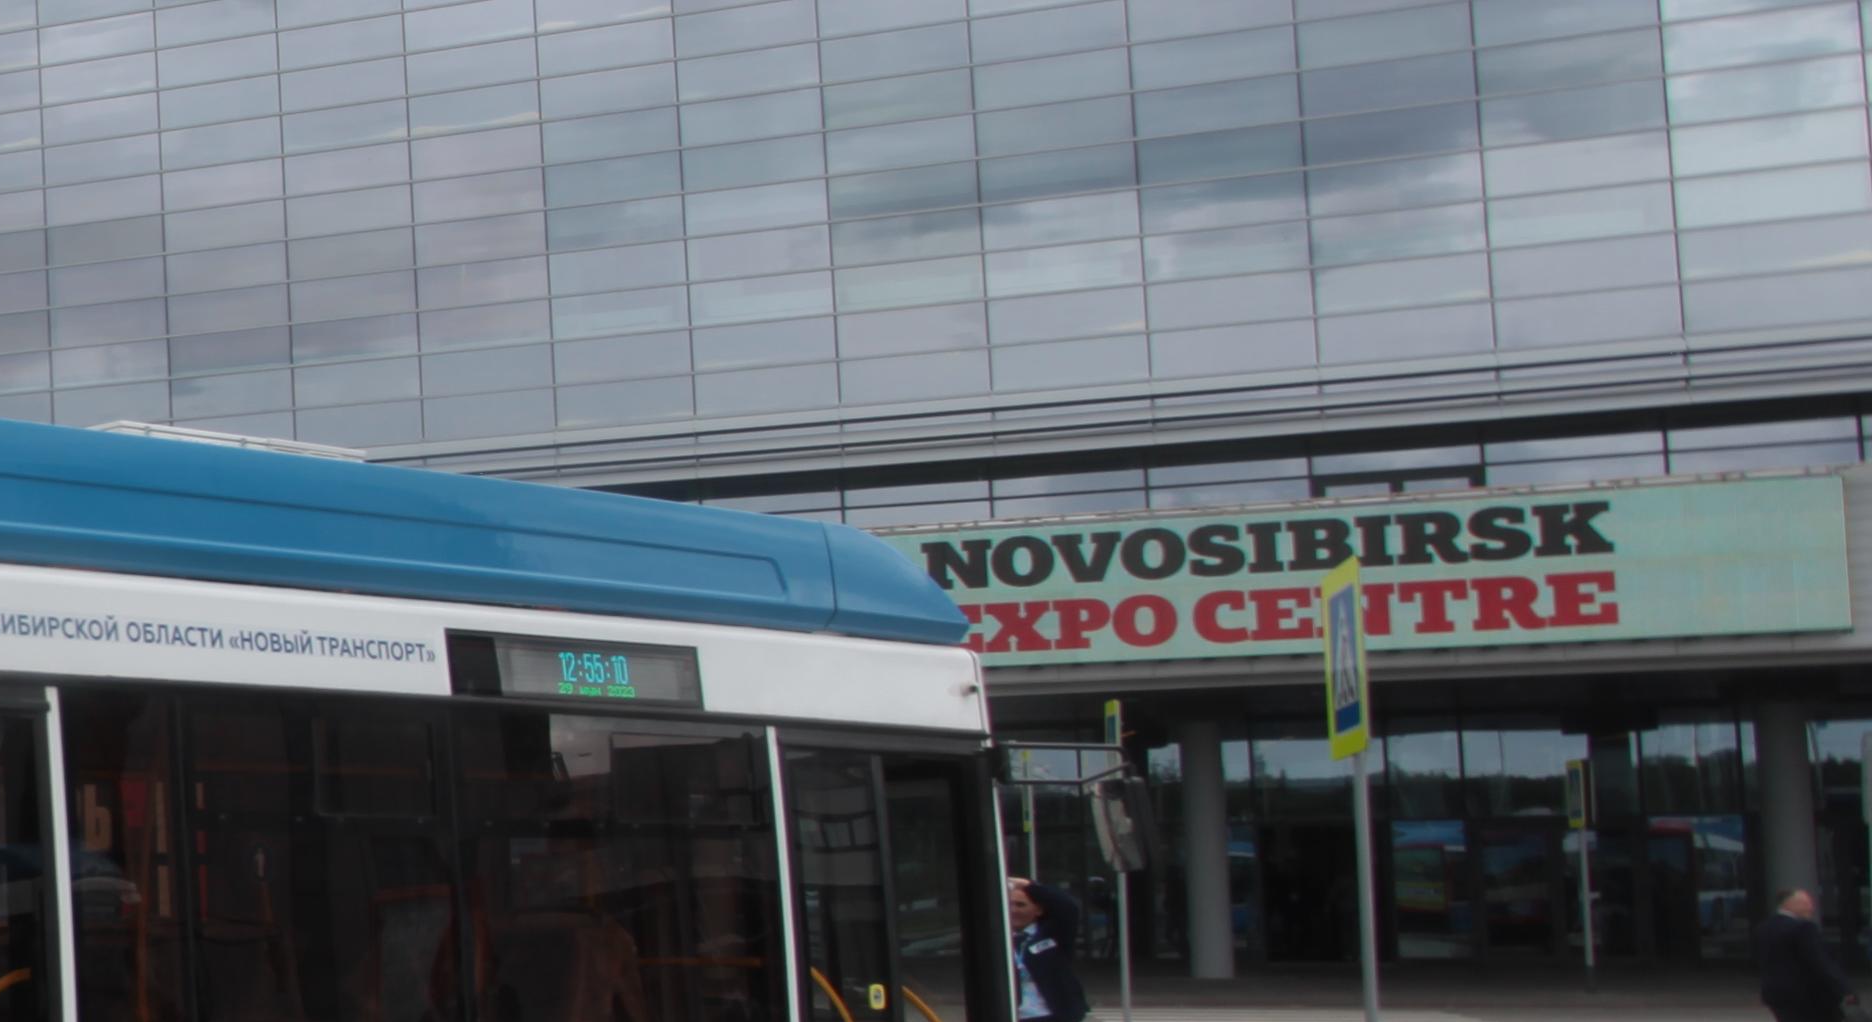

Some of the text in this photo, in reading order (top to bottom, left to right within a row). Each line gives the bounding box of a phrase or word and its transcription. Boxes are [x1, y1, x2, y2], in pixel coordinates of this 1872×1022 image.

[920, 501, 1615, 591] NOVOSIBIRSK
[126, 622, 224, 649] ОБЛАСТИ
[229, 629, 314, 655] «НОВЫЙ
[317, 636, 436, 664] ТРАНСПОРТ»
[559, 651, 630, 685] 12:55:10
